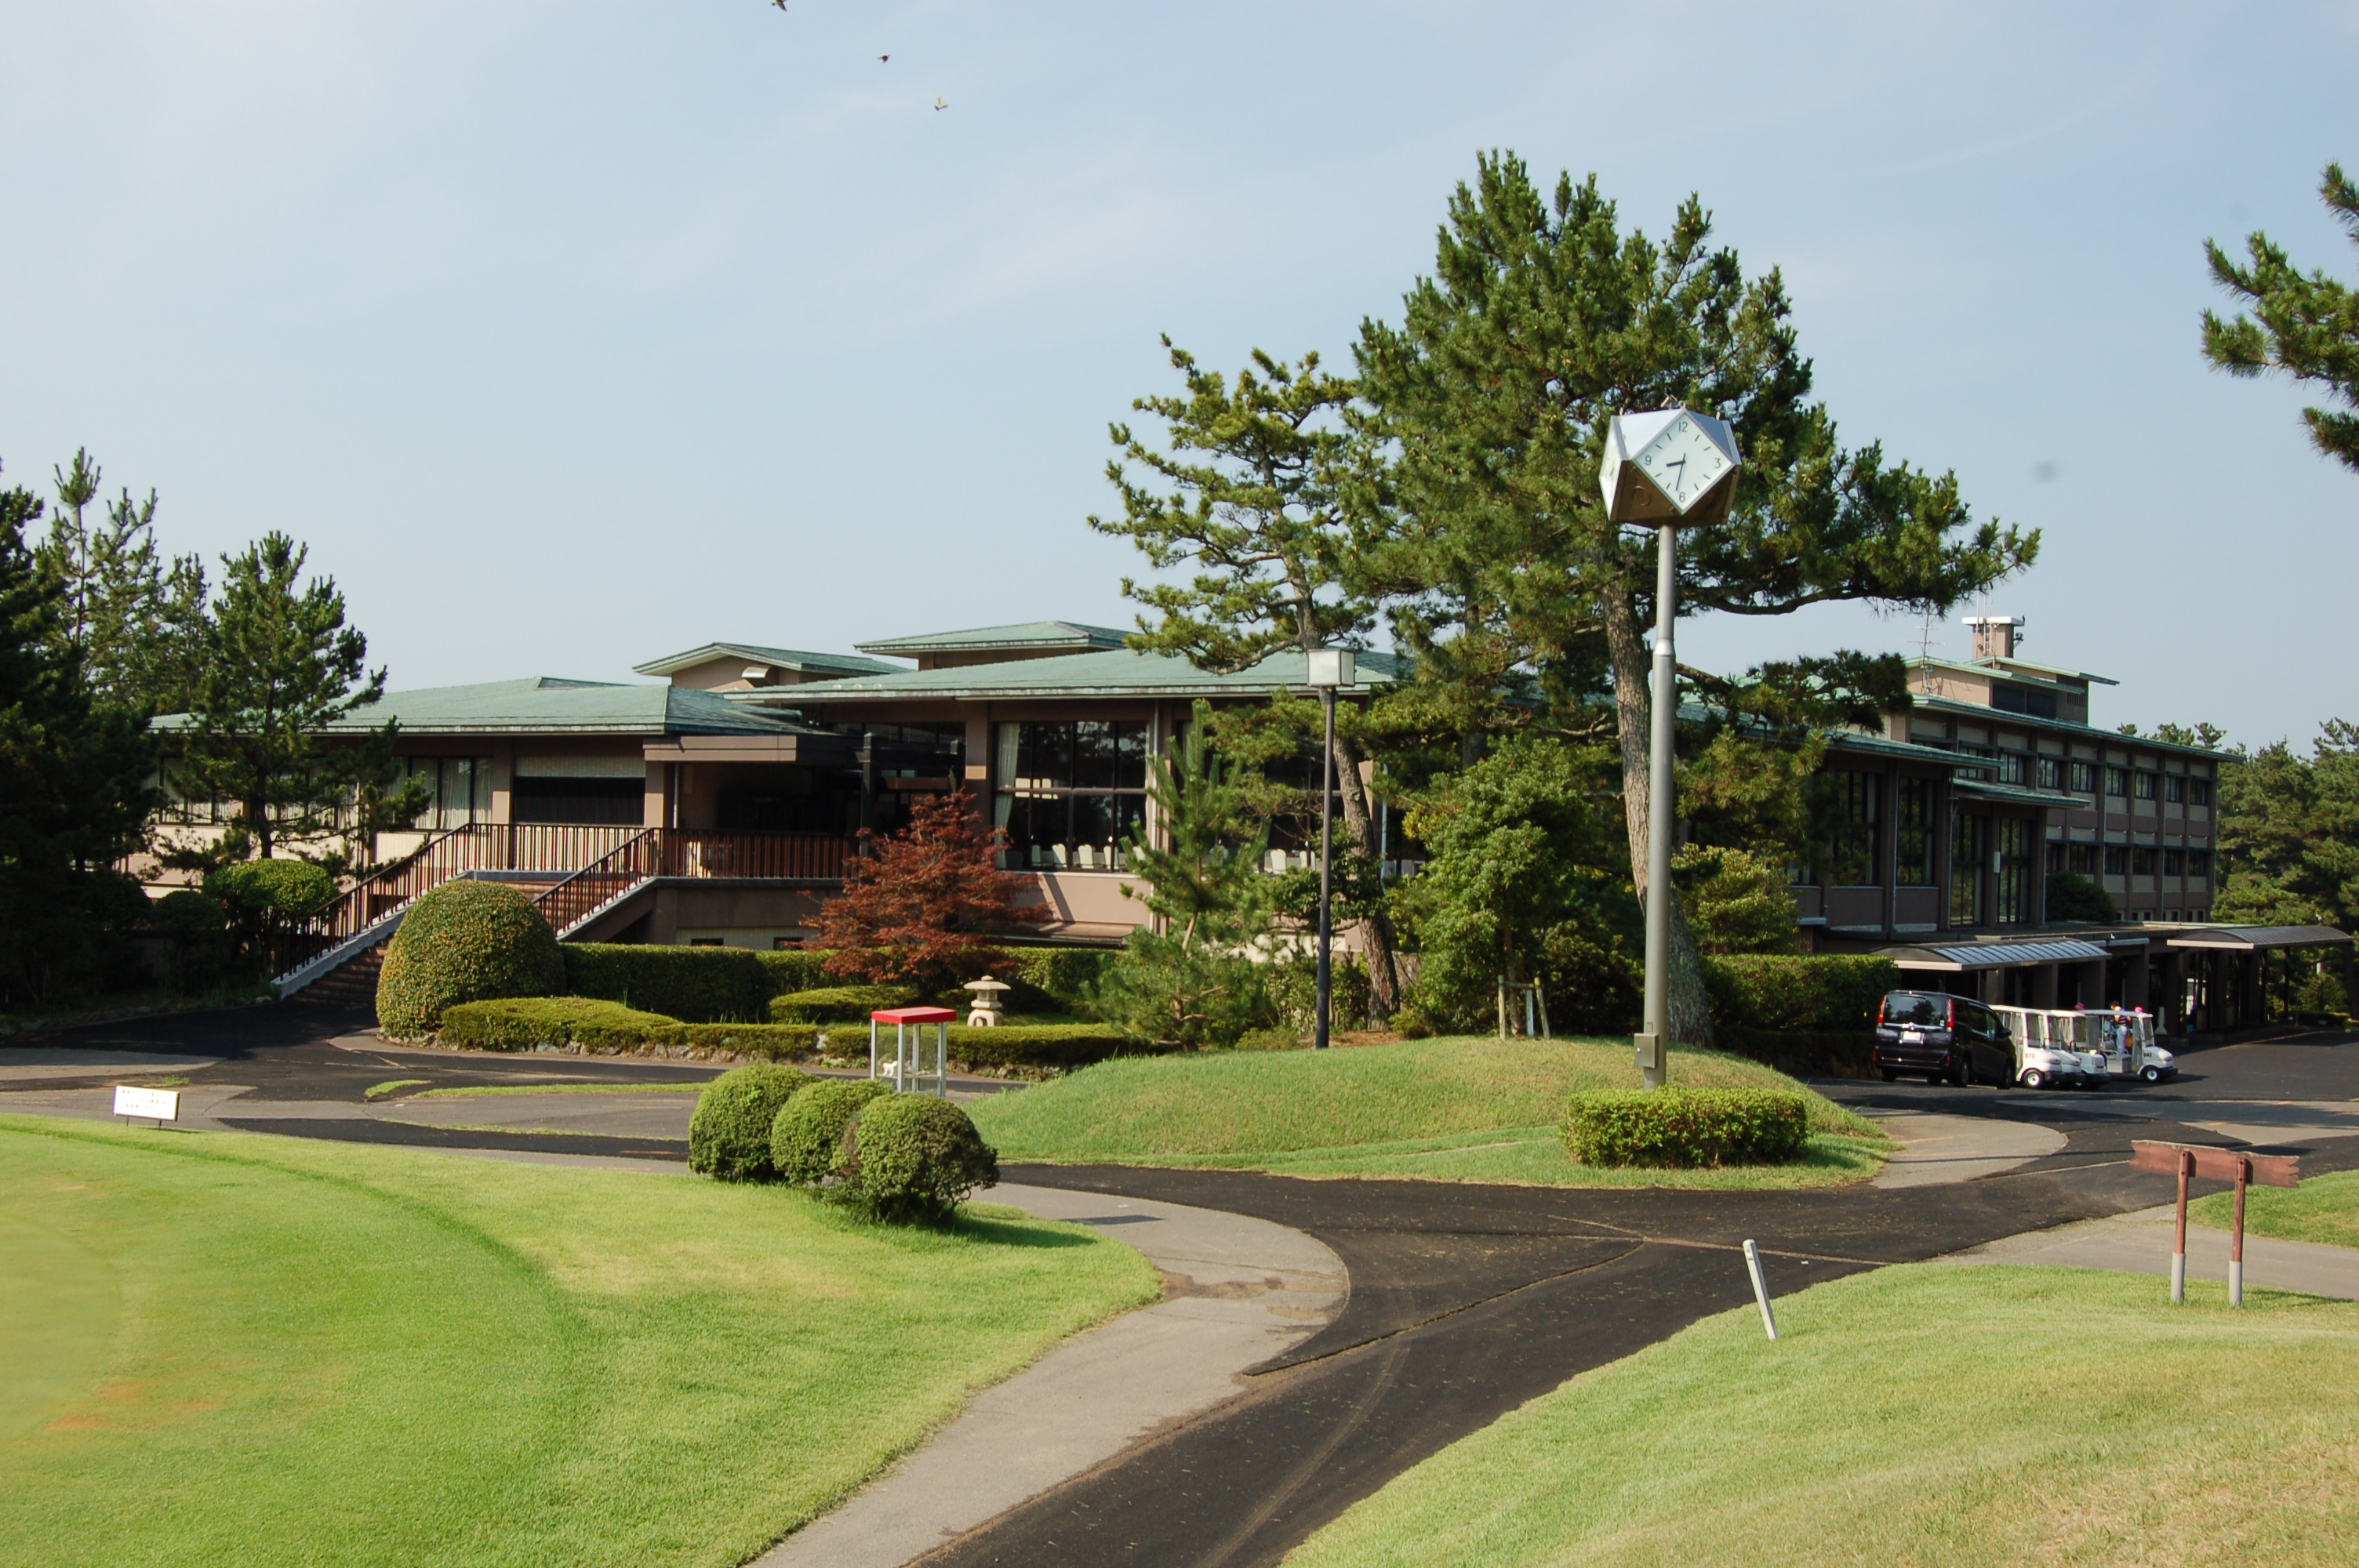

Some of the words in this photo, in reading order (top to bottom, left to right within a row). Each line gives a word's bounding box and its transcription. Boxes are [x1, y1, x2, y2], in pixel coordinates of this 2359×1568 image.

[1678, 422, 1688, 432] 12
[1645, 455, 1652, 465] 9
[1714, 458, 1721, 468] 3
[1679, 492, 1685, 503] 6
